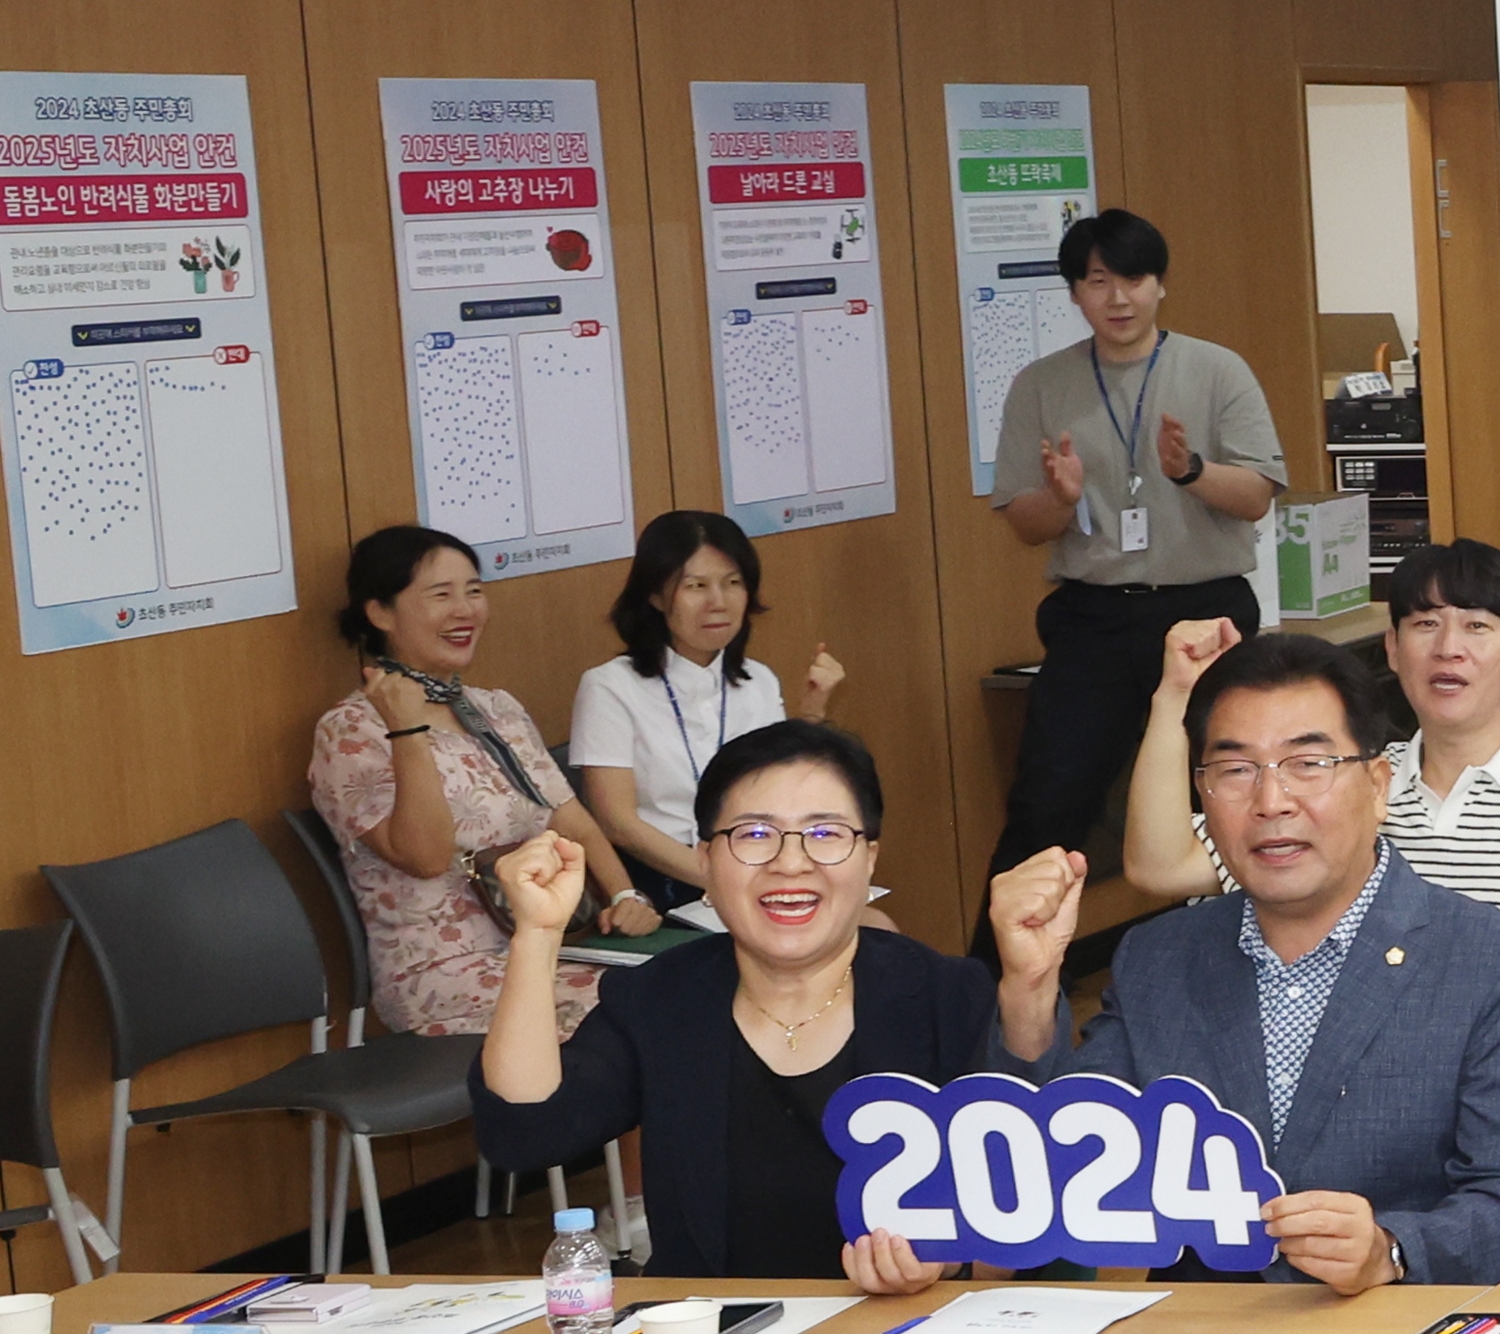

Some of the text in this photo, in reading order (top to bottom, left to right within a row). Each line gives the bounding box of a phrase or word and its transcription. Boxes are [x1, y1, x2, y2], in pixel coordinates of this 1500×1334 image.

[35, 96, 194, 122] 2024 초산동 주민총회
[431, 100, 555, 123] 2024 초산동 주민총회
[0, 132, 237, 170] 2025년도 자치사업 안건
[401, 132, 589, 166] 2025년도 자치사업 안건
[709, 132, 773, 160] 2025년도
[740, 172, 780, 197] 날아라
[811, 170, 836, 194] 교실
[987, 163, 1018, 185] 초산동
[3, 182, 238, 217] 돌봄노인 반려식물 화분만들기
[425, 176, 575, 206] 사랑의 고추장 나누기
[139, 604, 166, 620] 초산동
[847, 1100, 1262, 1246] 2024
